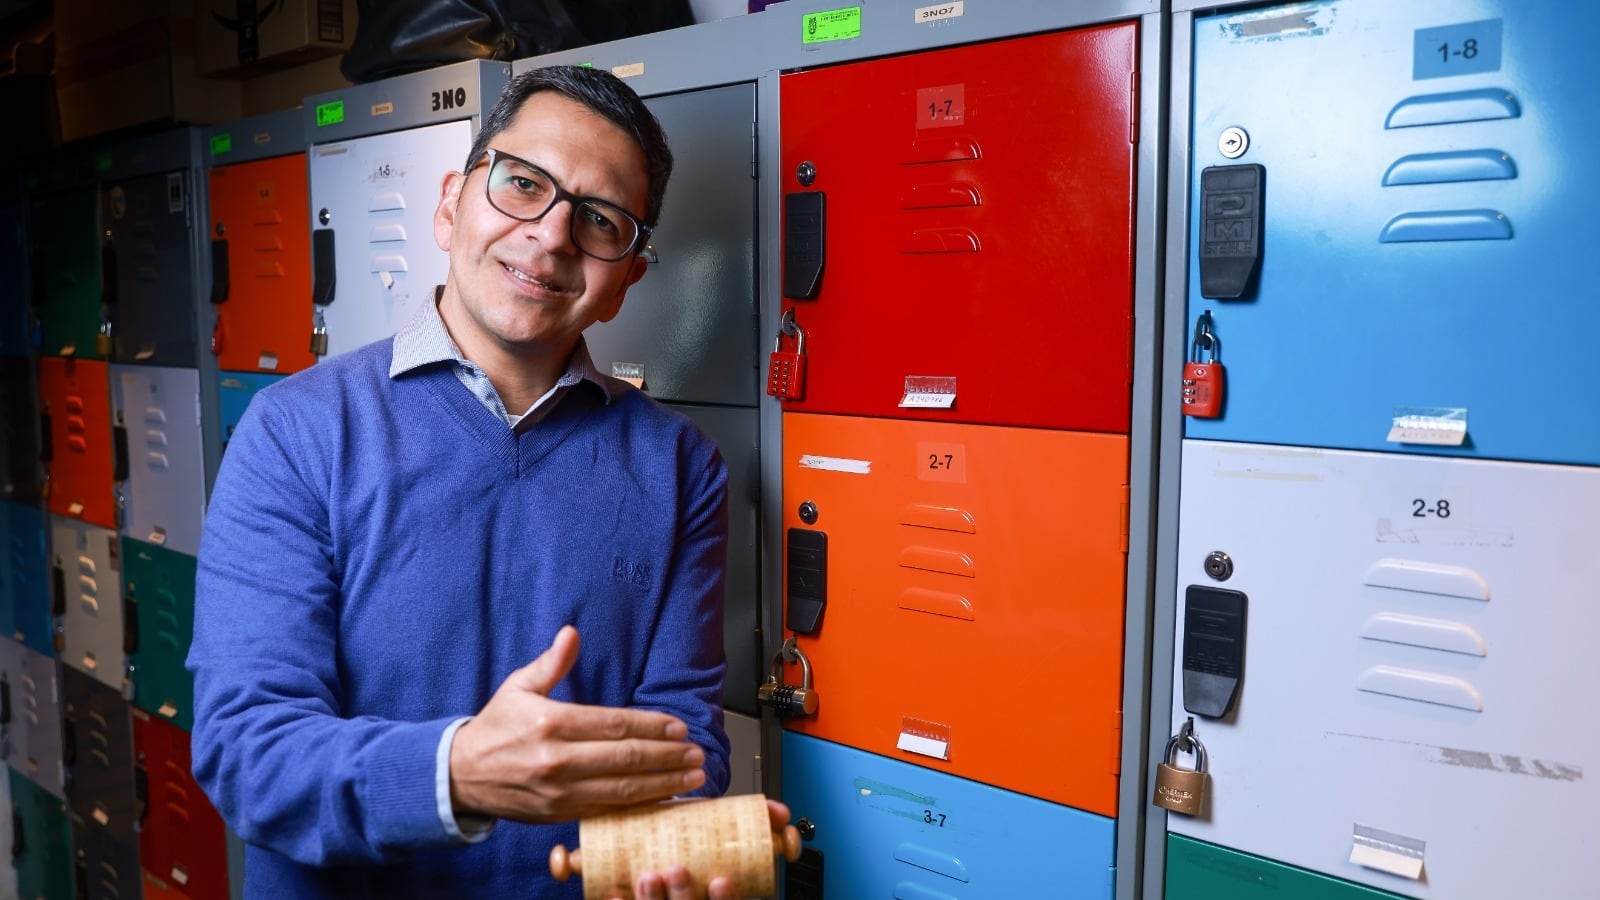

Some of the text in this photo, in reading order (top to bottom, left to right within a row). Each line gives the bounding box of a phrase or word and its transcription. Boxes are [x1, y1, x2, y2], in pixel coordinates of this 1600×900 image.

[1437, 38, 1478, 63] 1-8
[431, 87, 466, 111] 3NO
[928, 99, 953, 118] 1-7
[378, 164, 391, 177] 1-5
[928, 454, 954, 470] 2-7
[1412, 498, 1451, 519] 2-8
[923, 809, 947, 828] 3-7
